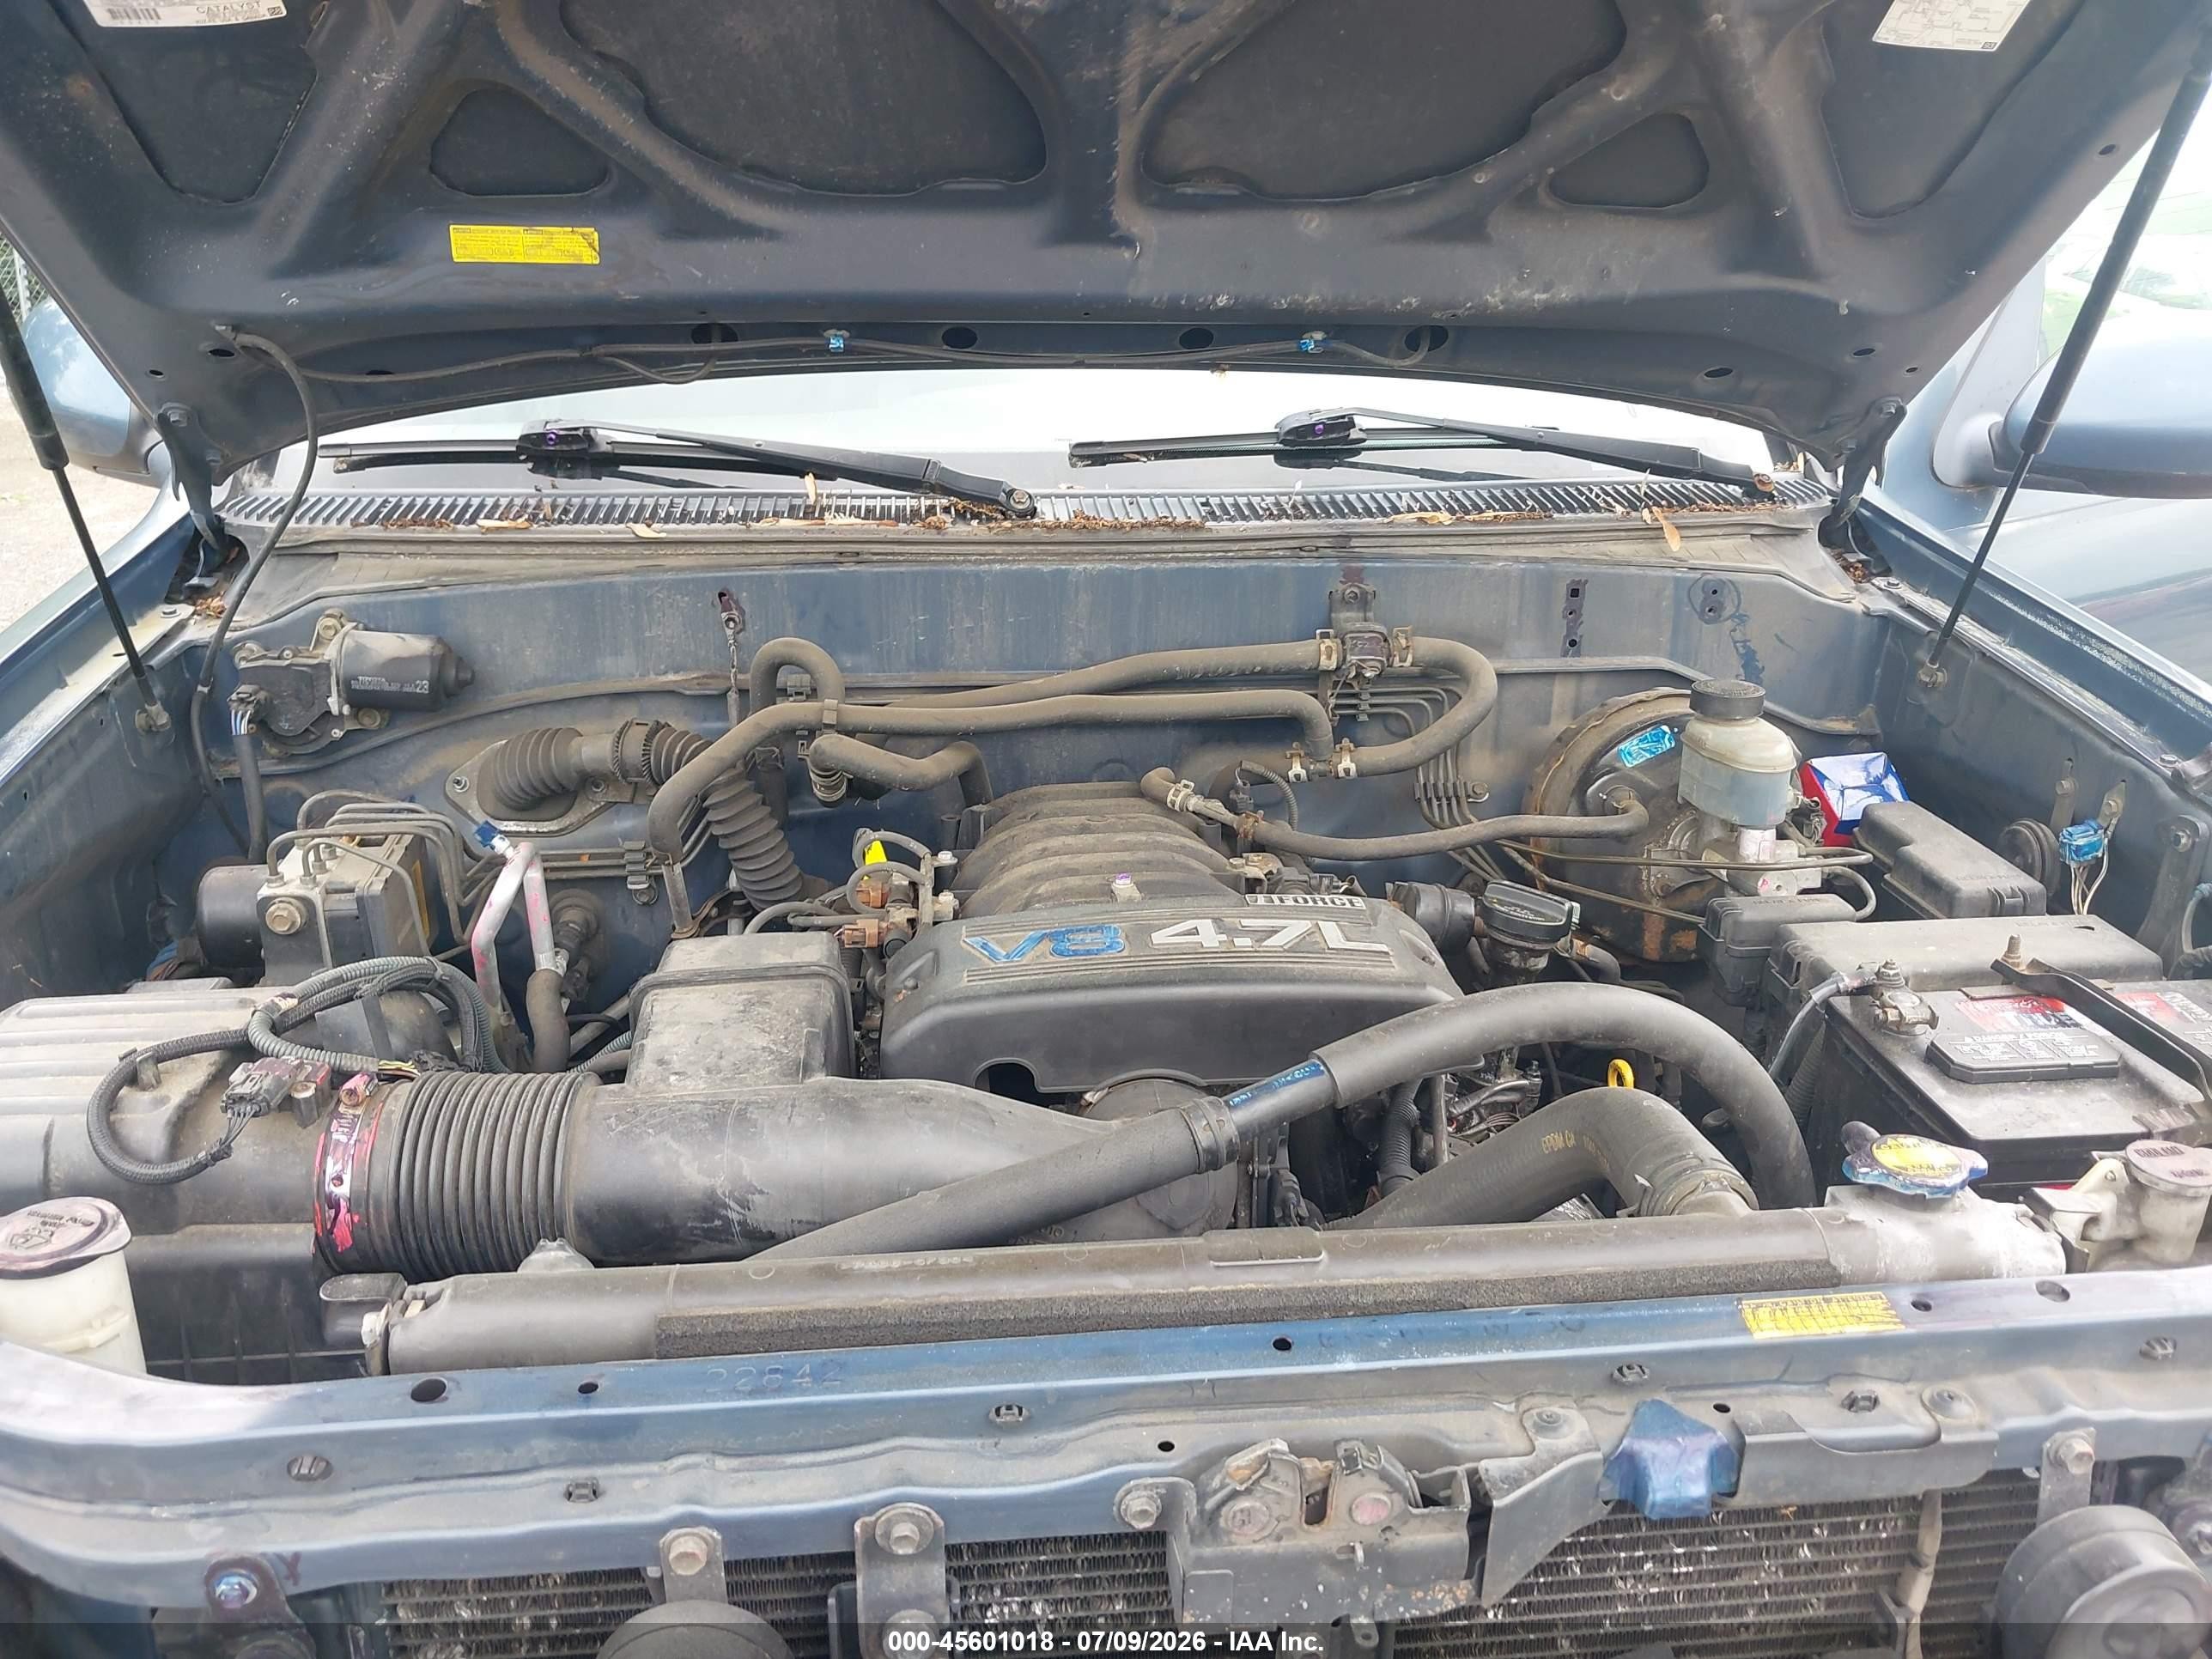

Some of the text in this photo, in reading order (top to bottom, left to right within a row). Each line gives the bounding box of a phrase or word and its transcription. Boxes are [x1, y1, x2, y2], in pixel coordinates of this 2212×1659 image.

[416, 680, 429, 694] 23
[962, 919, 1390, 963] V8 4.7L
